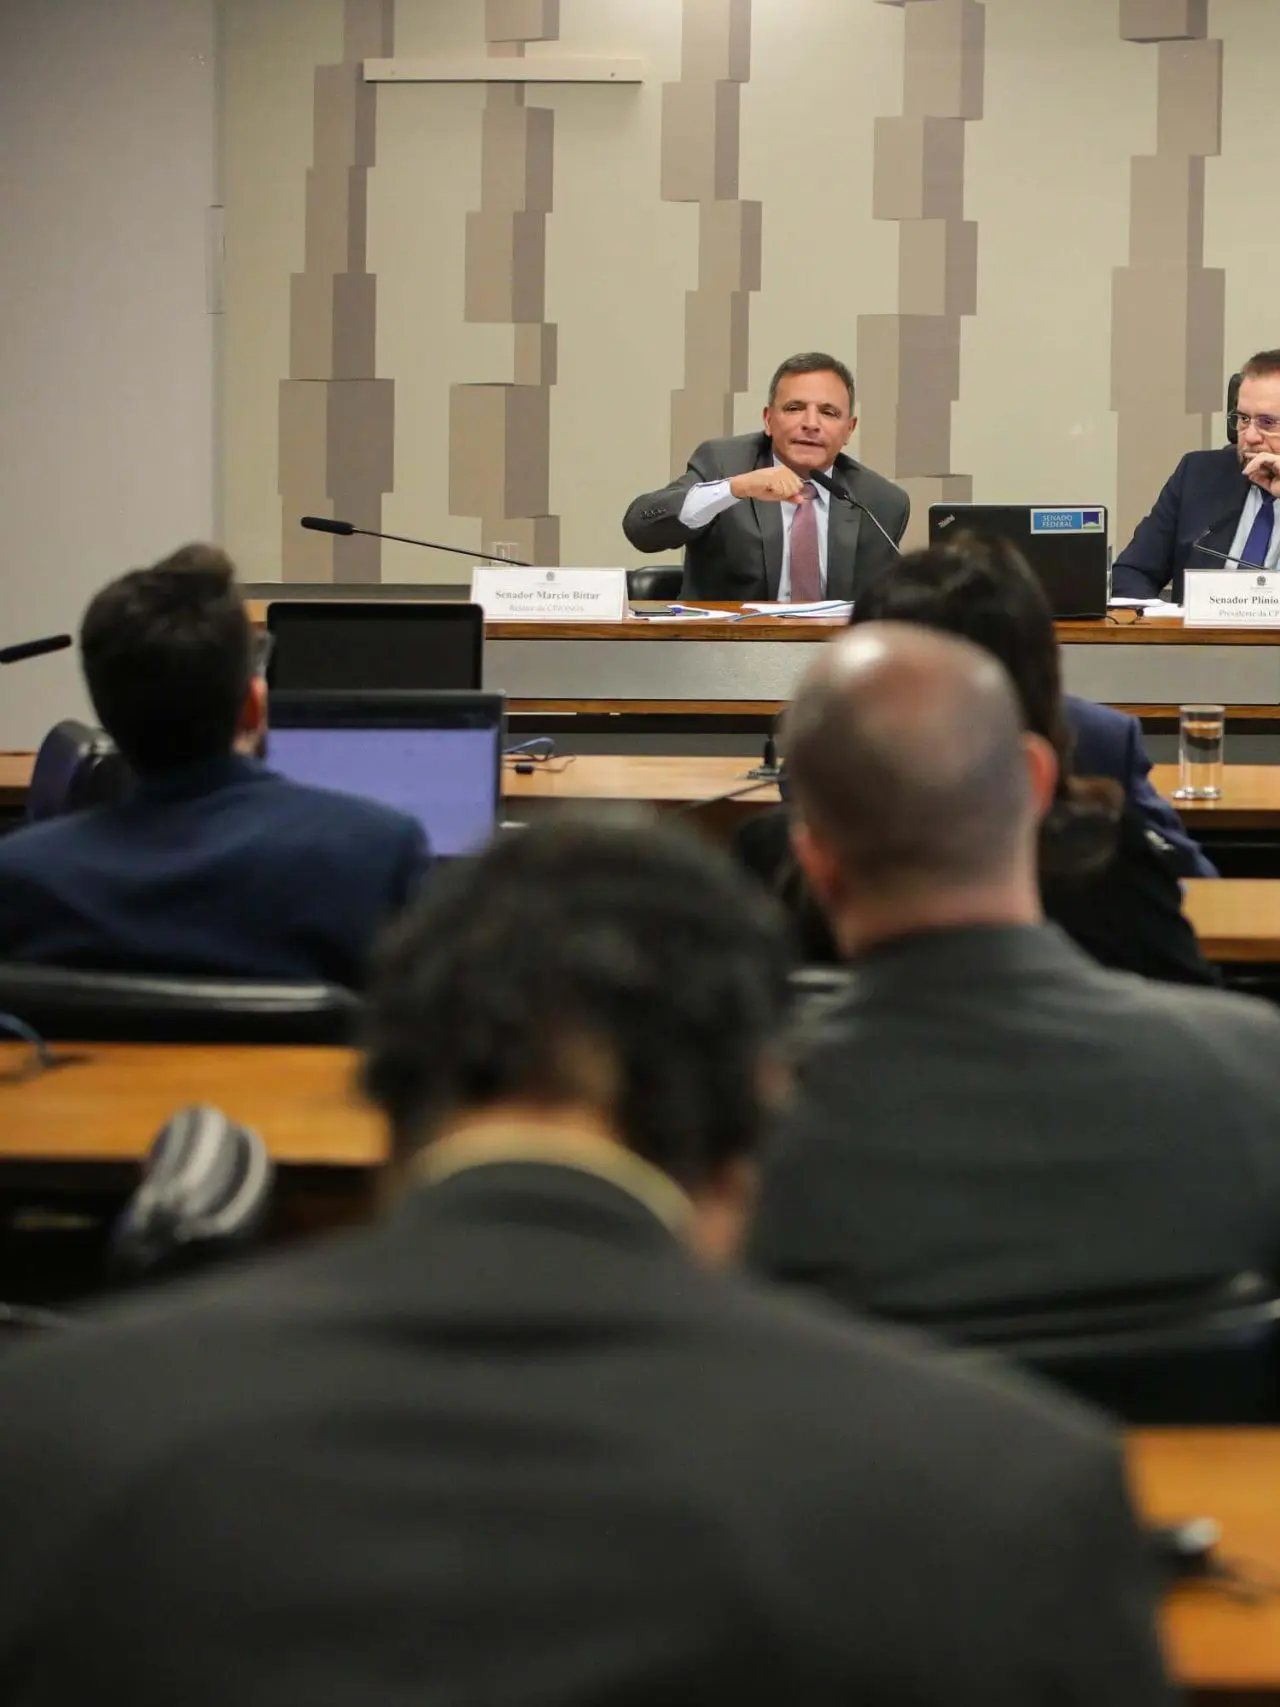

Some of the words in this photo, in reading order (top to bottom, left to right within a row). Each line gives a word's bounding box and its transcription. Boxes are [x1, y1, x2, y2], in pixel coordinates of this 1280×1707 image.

[495, 590, 534, 600] Senador
[573, 591, 601, 600] Bittar
[1209, 595, 1248, 604] Senador
[1219, 609, 1255, 618] Presidente
